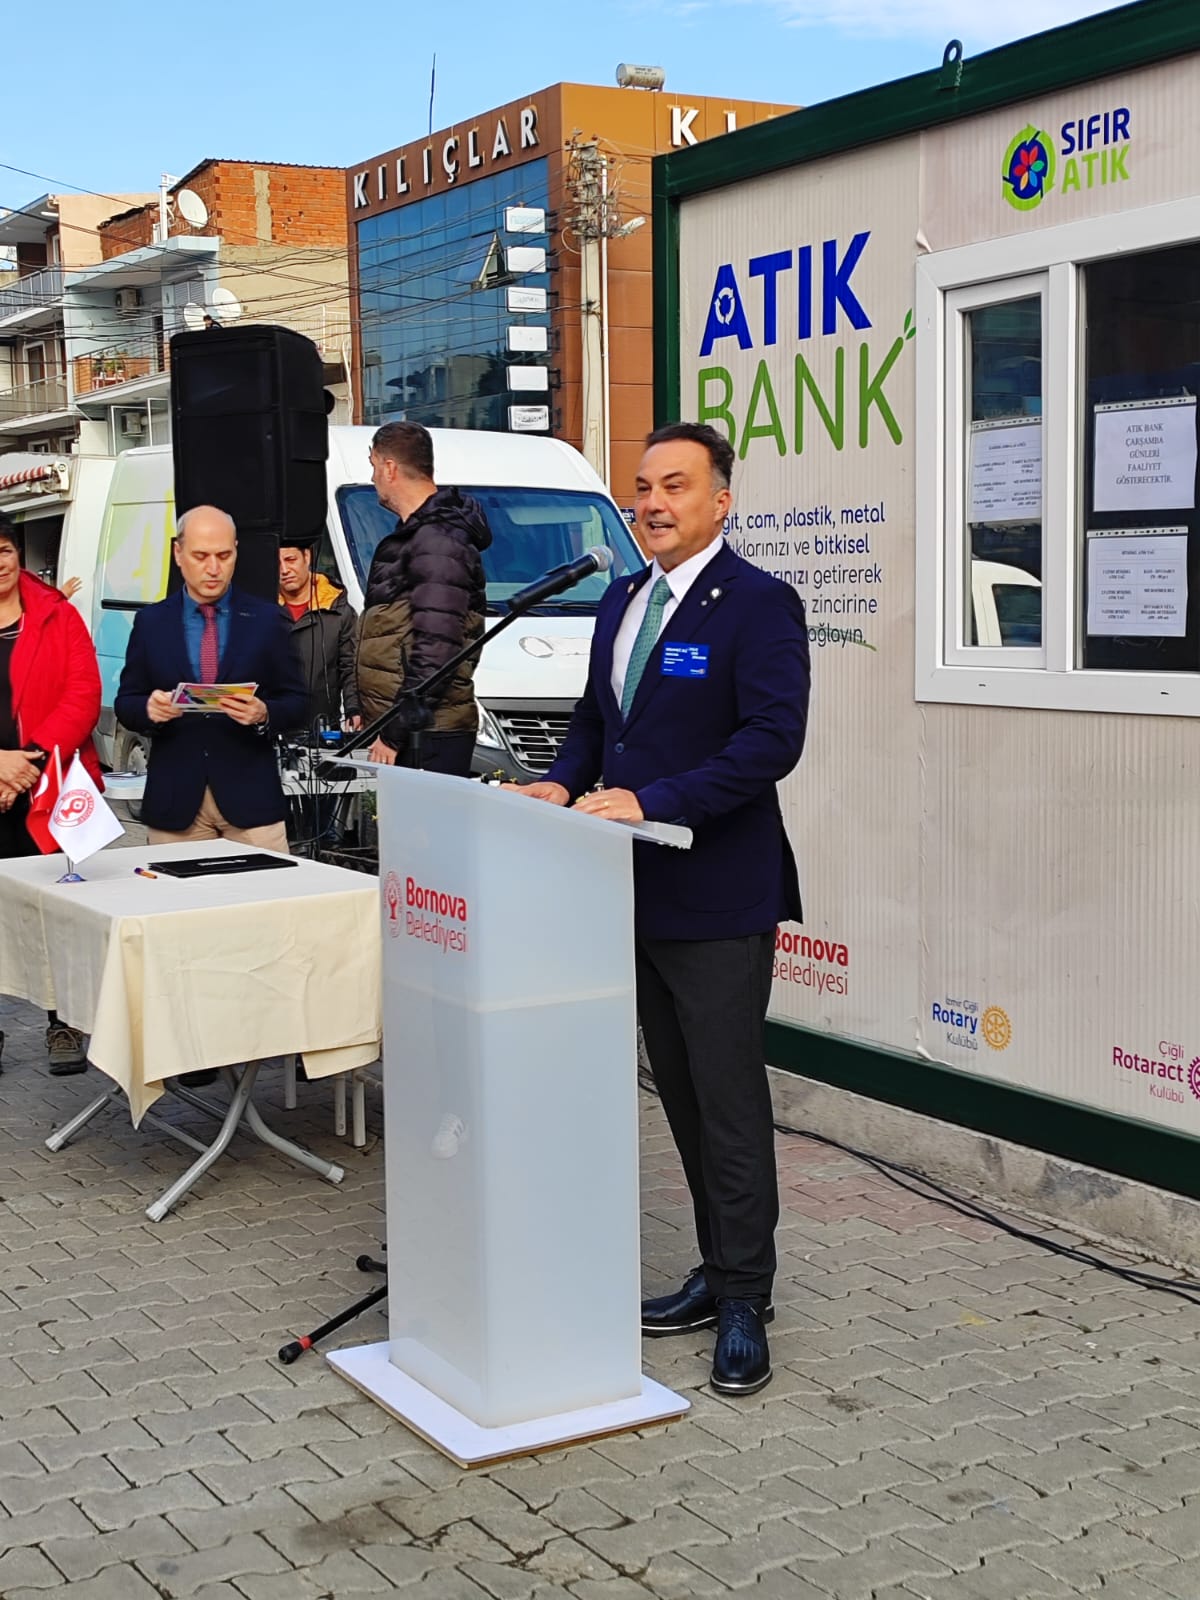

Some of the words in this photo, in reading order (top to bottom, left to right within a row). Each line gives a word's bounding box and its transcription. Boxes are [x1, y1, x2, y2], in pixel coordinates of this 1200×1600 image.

[1061, 107, 1130, 156] SIFIR
[354, 106, 540, 209] KILIÇLAR
[1061, 143, 1131, 195] ATIK
[699, 230, 873, 358] ATIK
[698, 336, 904, 461] BANK
[1126, 424, 1143, 434] ATIK
[1144, 423, 1164, 432] BANK
[1128, 463, 1162, 472] FAALİYET
[1129, 449, 1160, 459] GÜNLERİ
[746, 512, 780, 532] cam,
[783, 505, 836, 533] plastik,
[841, 501, 886, 524] metal
[727, 537, 790, 558] ıklarınızı
[794, 540, 810, 556] ve
[815, 533, 870, 555] bitkisel
[813, 563, 882, 590] getirerek
[812, 593, 878, 614] zincirine
[406, 877, 467, 922] Bornova
[406, 911, 467, 954] Belediyesi
[772, 956, 848, 996] Belediyesi
[932, 1002, 978, 1035] Rotary
[946, 1031, 978, 1051] Kulübü
[1158, 1040, 1185, 1061] Çiğli
[1113, 1046, 1184, 1083] Rotaract
[1149, 1083, 1185, 1104] Kulübü
